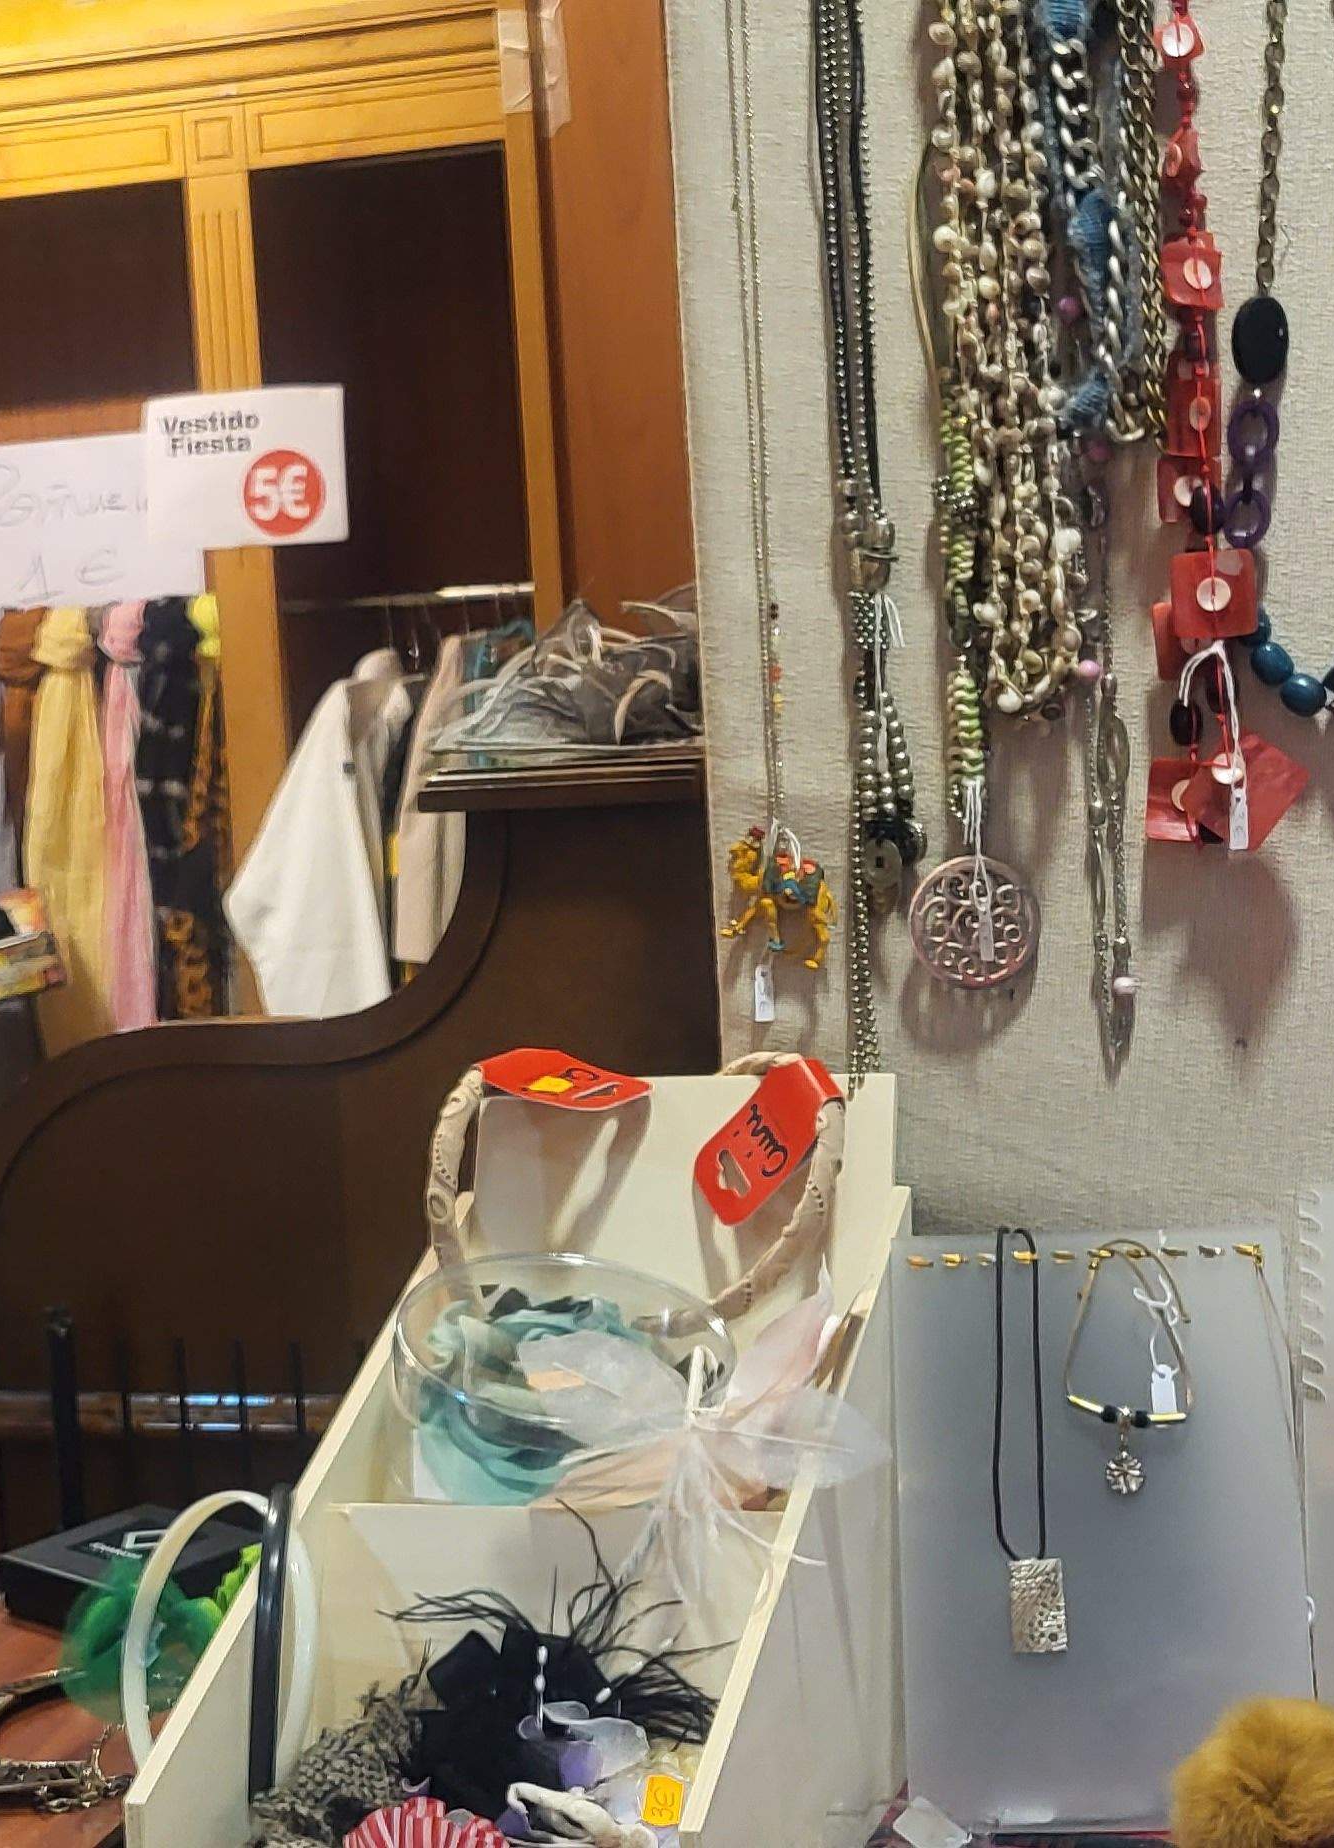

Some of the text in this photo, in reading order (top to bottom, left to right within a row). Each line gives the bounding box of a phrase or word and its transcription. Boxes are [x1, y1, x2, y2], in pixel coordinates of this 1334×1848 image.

[163, 410, 260, 435] Vestido
[170, 435, 252, 457] Fiesta
[248, 465, 310, 521] 5€
